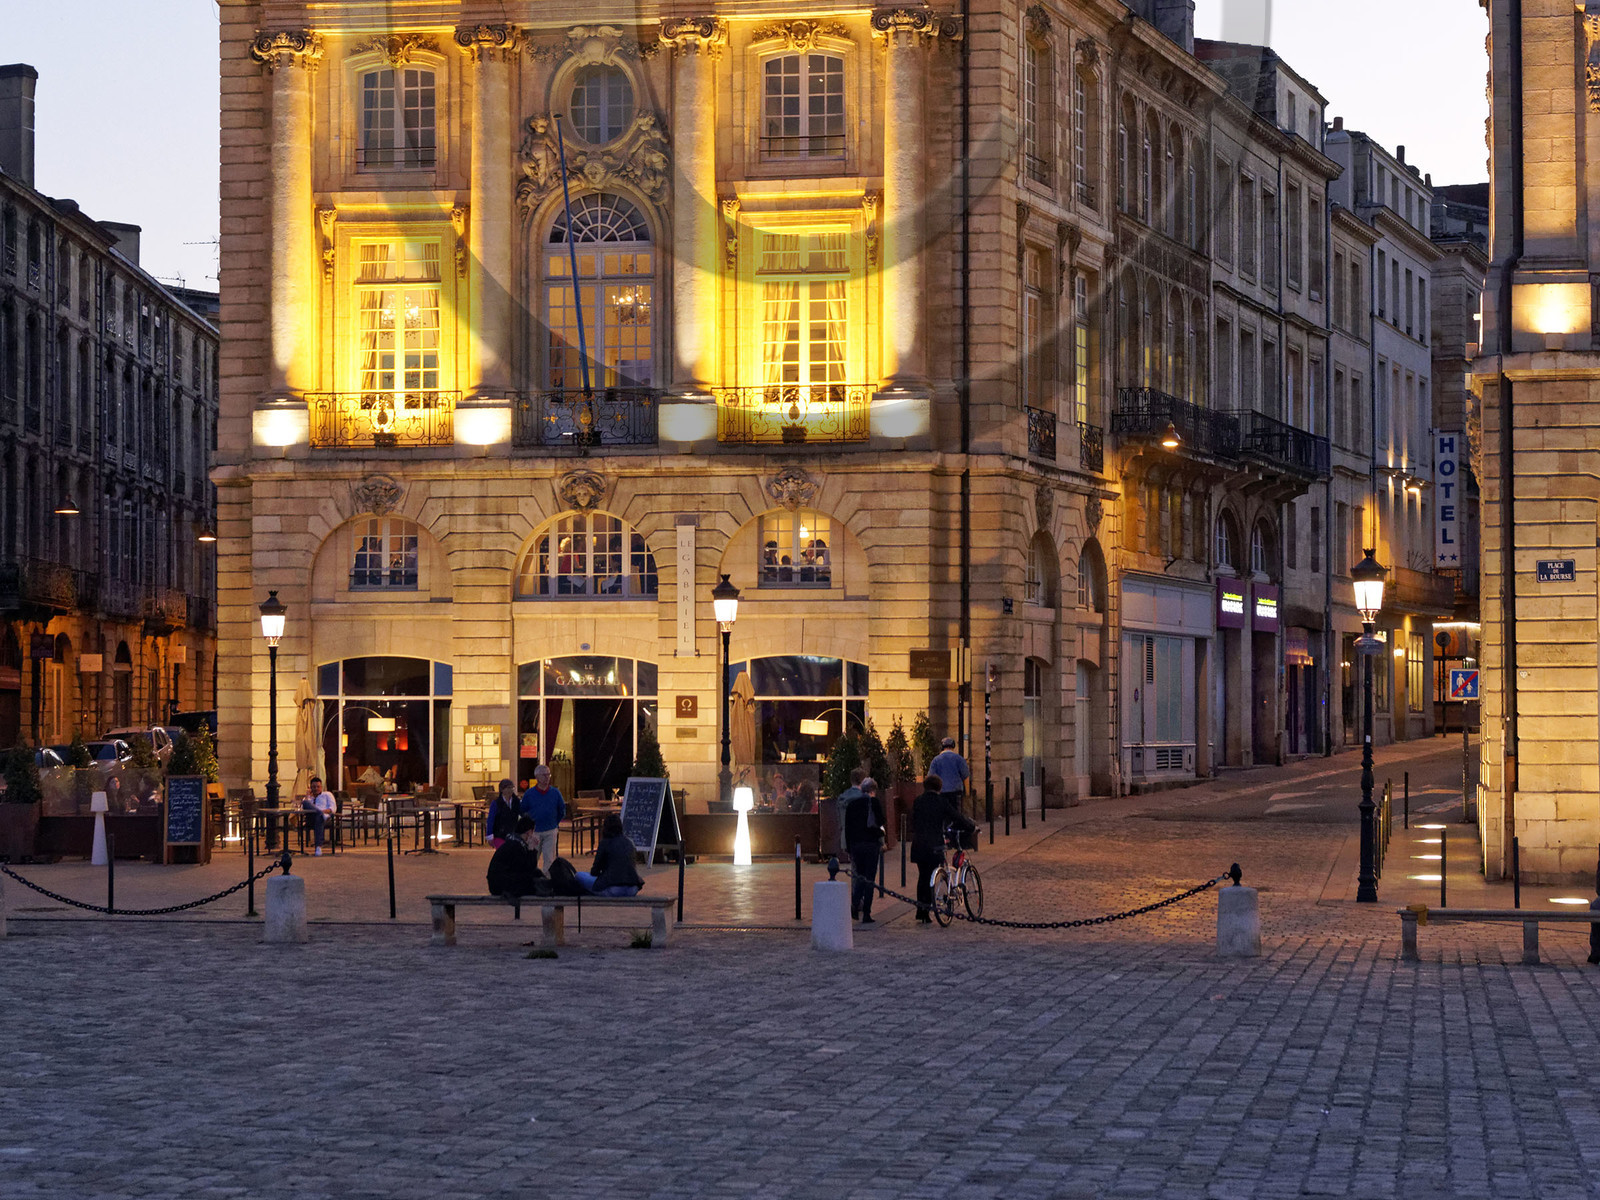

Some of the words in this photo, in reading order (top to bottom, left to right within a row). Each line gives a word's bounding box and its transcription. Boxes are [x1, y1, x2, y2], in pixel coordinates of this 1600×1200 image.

[1439, 437, 1455, 544] HOTEL
[680, 539, 693, 548] LE
[682, 553, 691, 643] GABRIEL
[556, 675, 621, 686] GABRIEL
